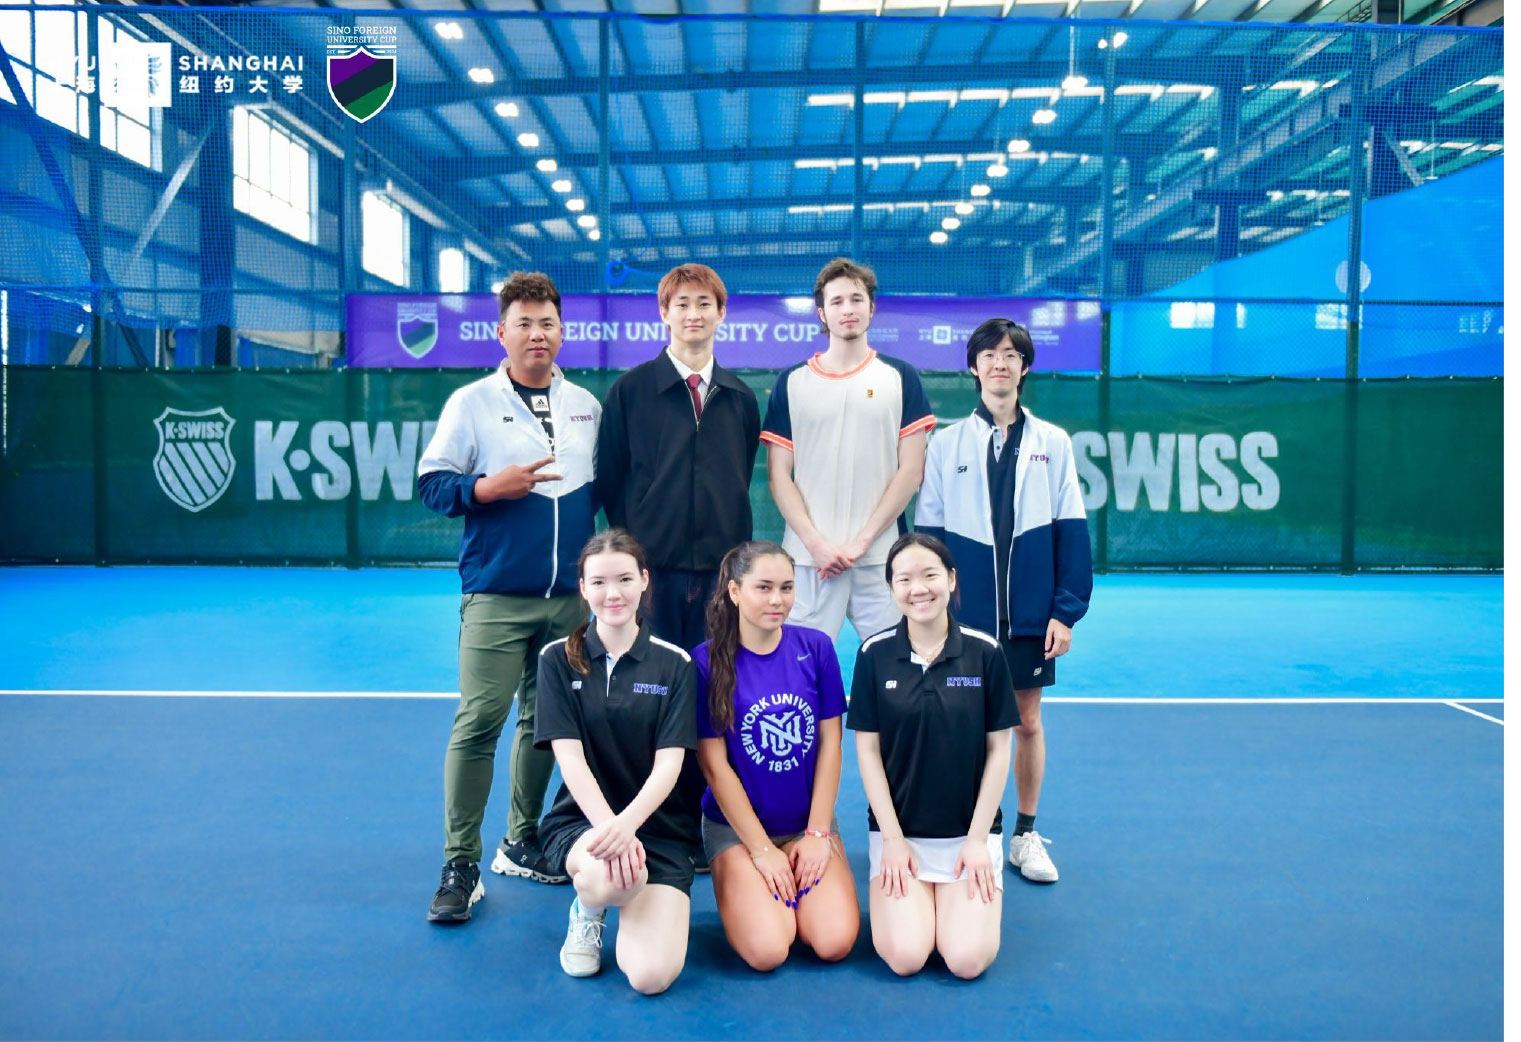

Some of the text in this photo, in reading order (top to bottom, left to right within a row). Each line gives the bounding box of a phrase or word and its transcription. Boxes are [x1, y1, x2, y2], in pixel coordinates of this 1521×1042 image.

[459, 321, 821, 342] SIN EIGN UNISITY CUP
[1070, 430, 1281, 513] SWISS
[740, 693, 816, 766] NEW YORK UNIVERSITY
[768, 755, 800, 773] 1831
